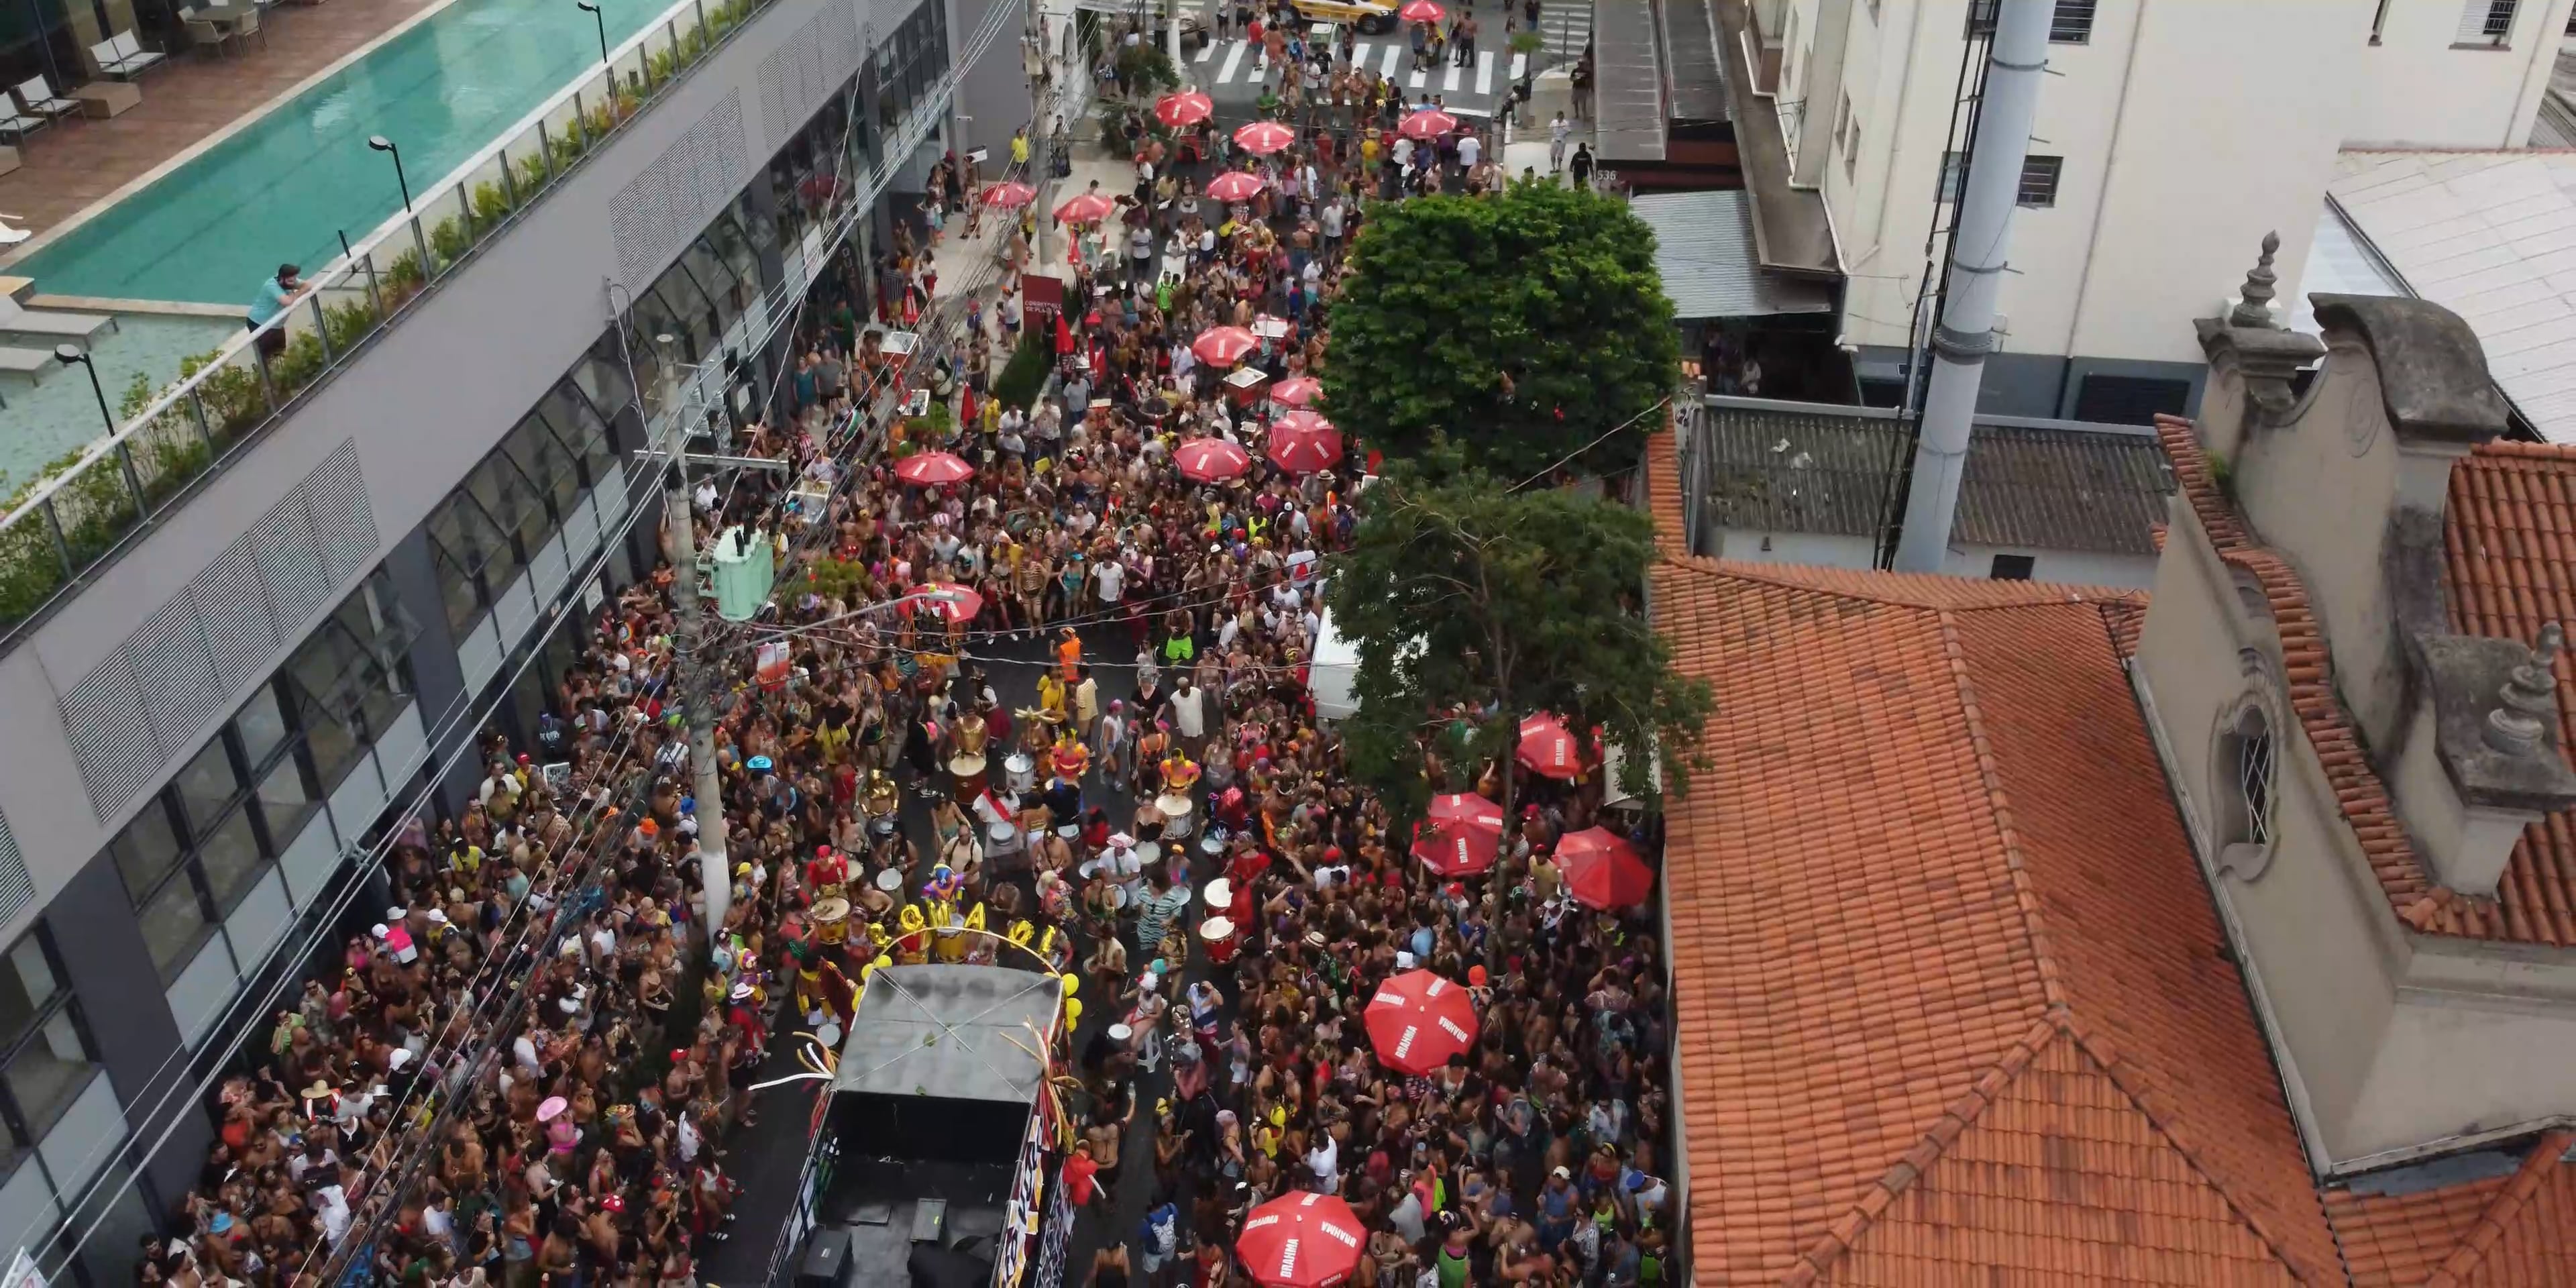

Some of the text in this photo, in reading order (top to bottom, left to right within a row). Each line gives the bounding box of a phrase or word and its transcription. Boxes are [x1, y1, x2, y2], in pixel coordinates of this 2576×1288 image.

[1597, 170, 1616, 180] 536
[1457, 837, 1468, 864] BRAHMA
[1395, 1025, 1417, 1059] BRAHMA
[1438, 1016, 1468, 1043] BRAHMA
[1321, 1221, 1357, 1248] BRAHMA
[1280, 1238, 1299, 1279] BRAHMA
